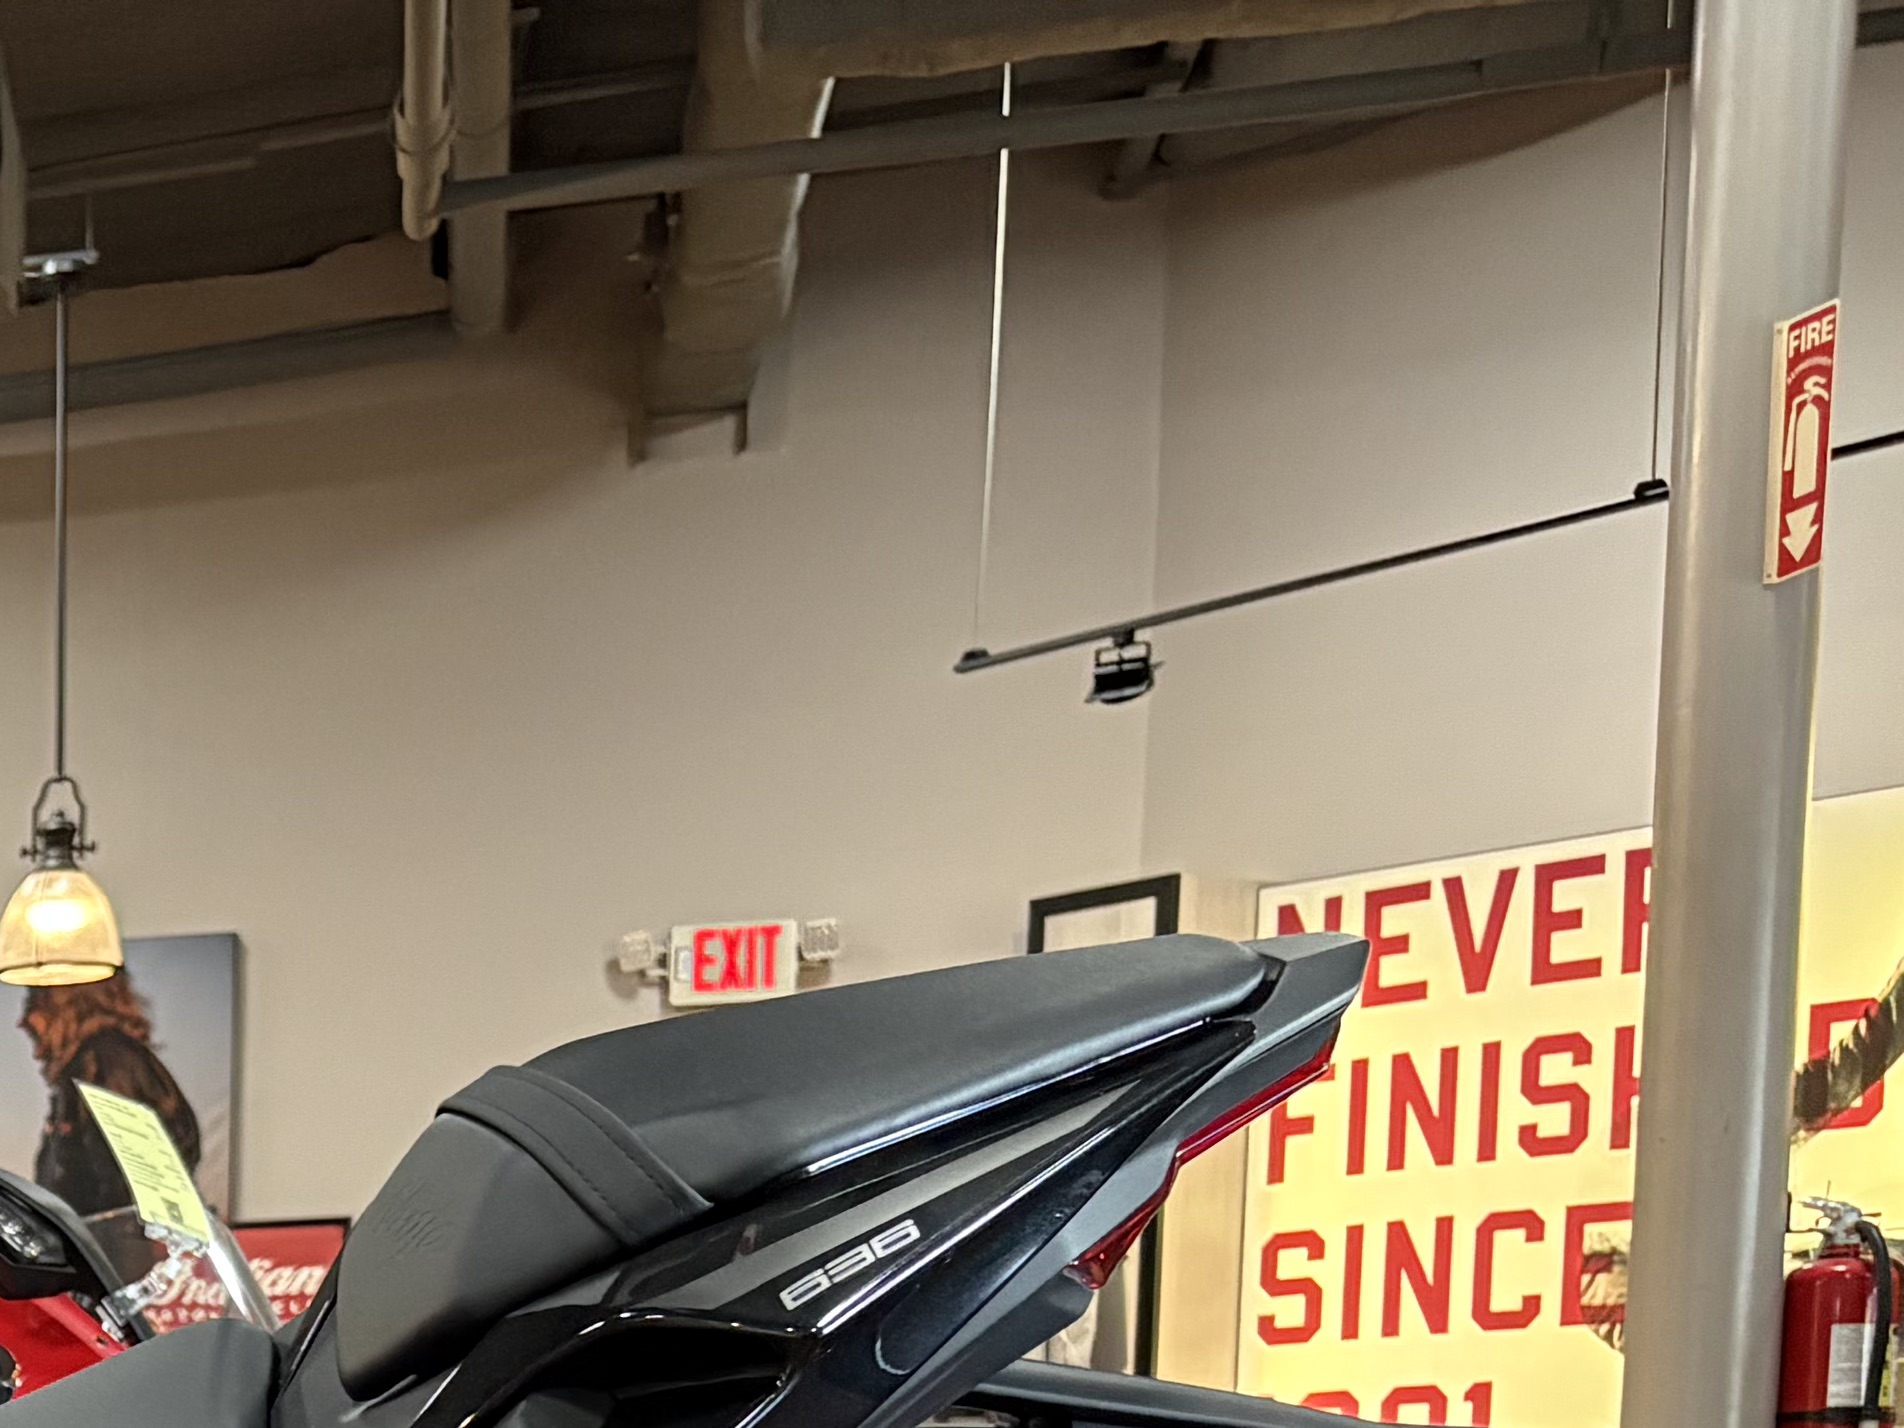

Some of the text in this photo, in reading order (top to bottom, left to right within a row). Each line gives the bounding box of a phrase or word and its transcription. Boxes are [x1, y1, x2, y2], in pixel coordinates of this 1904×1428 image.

[1788, 314, 1835, 358] FIRE
[692, 922, 783, 992] EXIT
[1277, 846, 1653, 1008] EVE
[779, 1218, 921, 1311] 636
